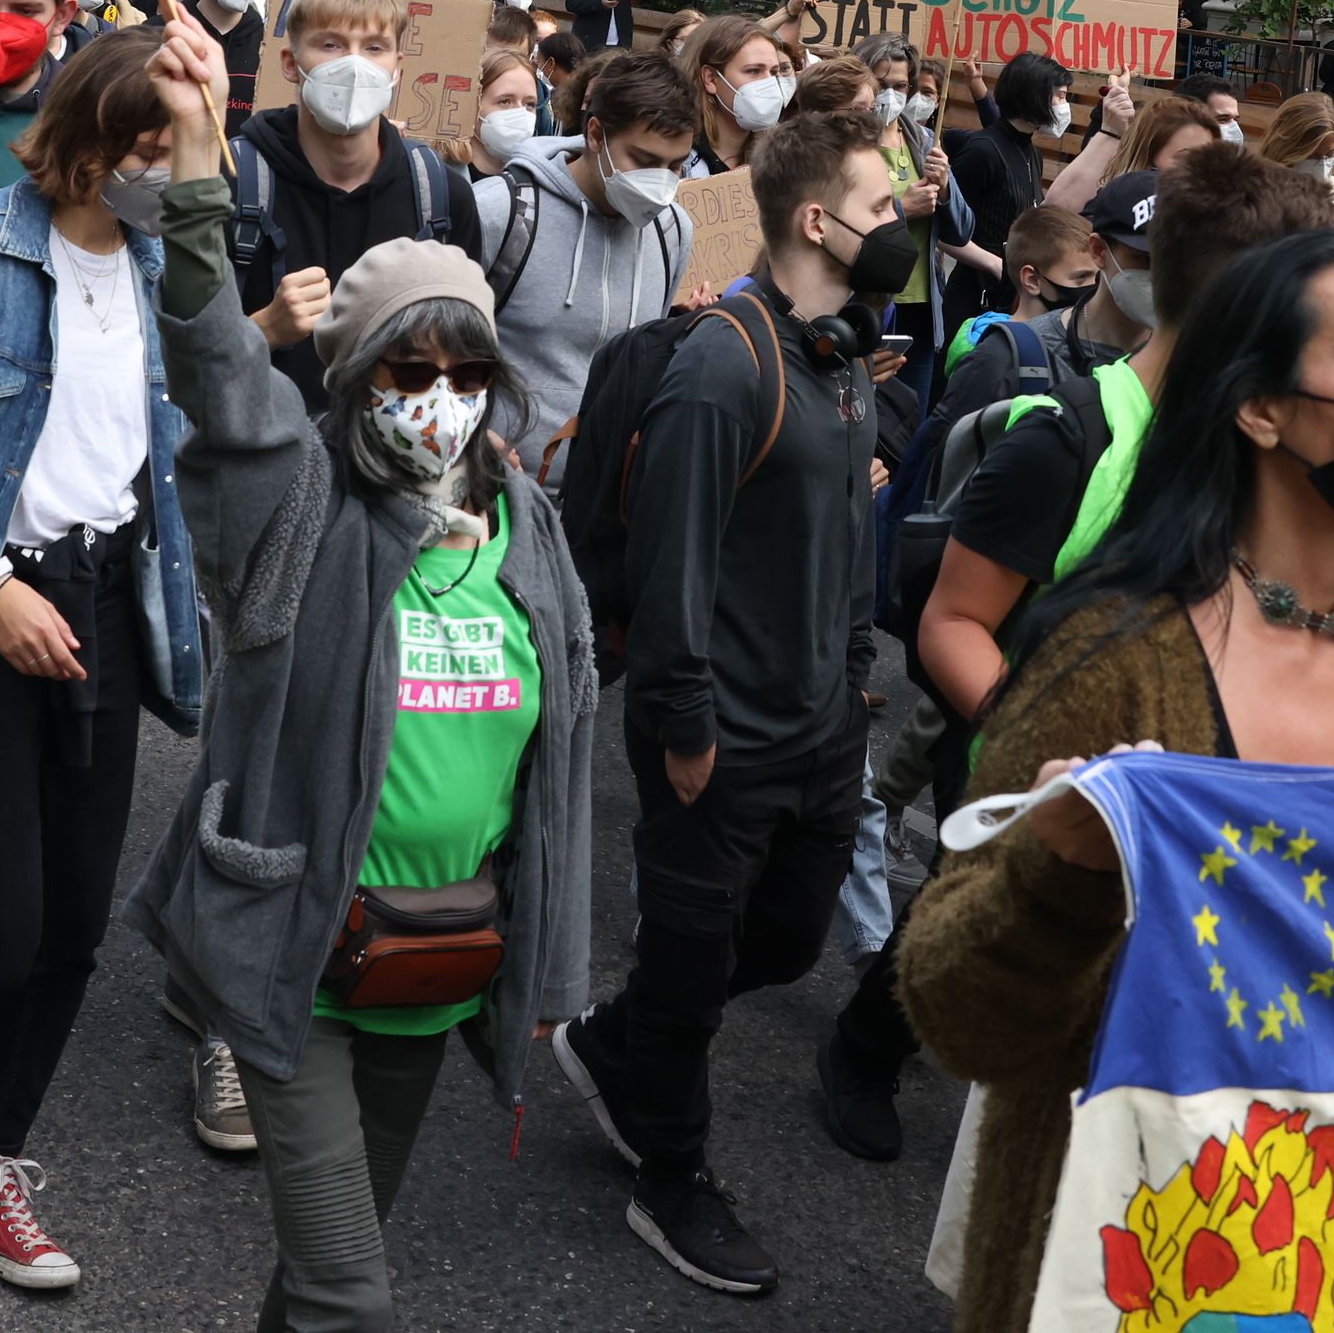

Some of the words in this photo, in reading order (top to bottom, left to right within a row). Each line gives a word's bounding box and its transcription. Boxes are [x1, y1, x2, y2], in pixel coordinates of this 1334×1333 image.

[926, 7, 1175, 78] AUTOSCHMUTZ
[407, 616, 437, 640] ES
[443, 622, 498, 643] GIBT
[407, 650, 499, 675] KEINEN
[493, 684, 517, 708] B.
